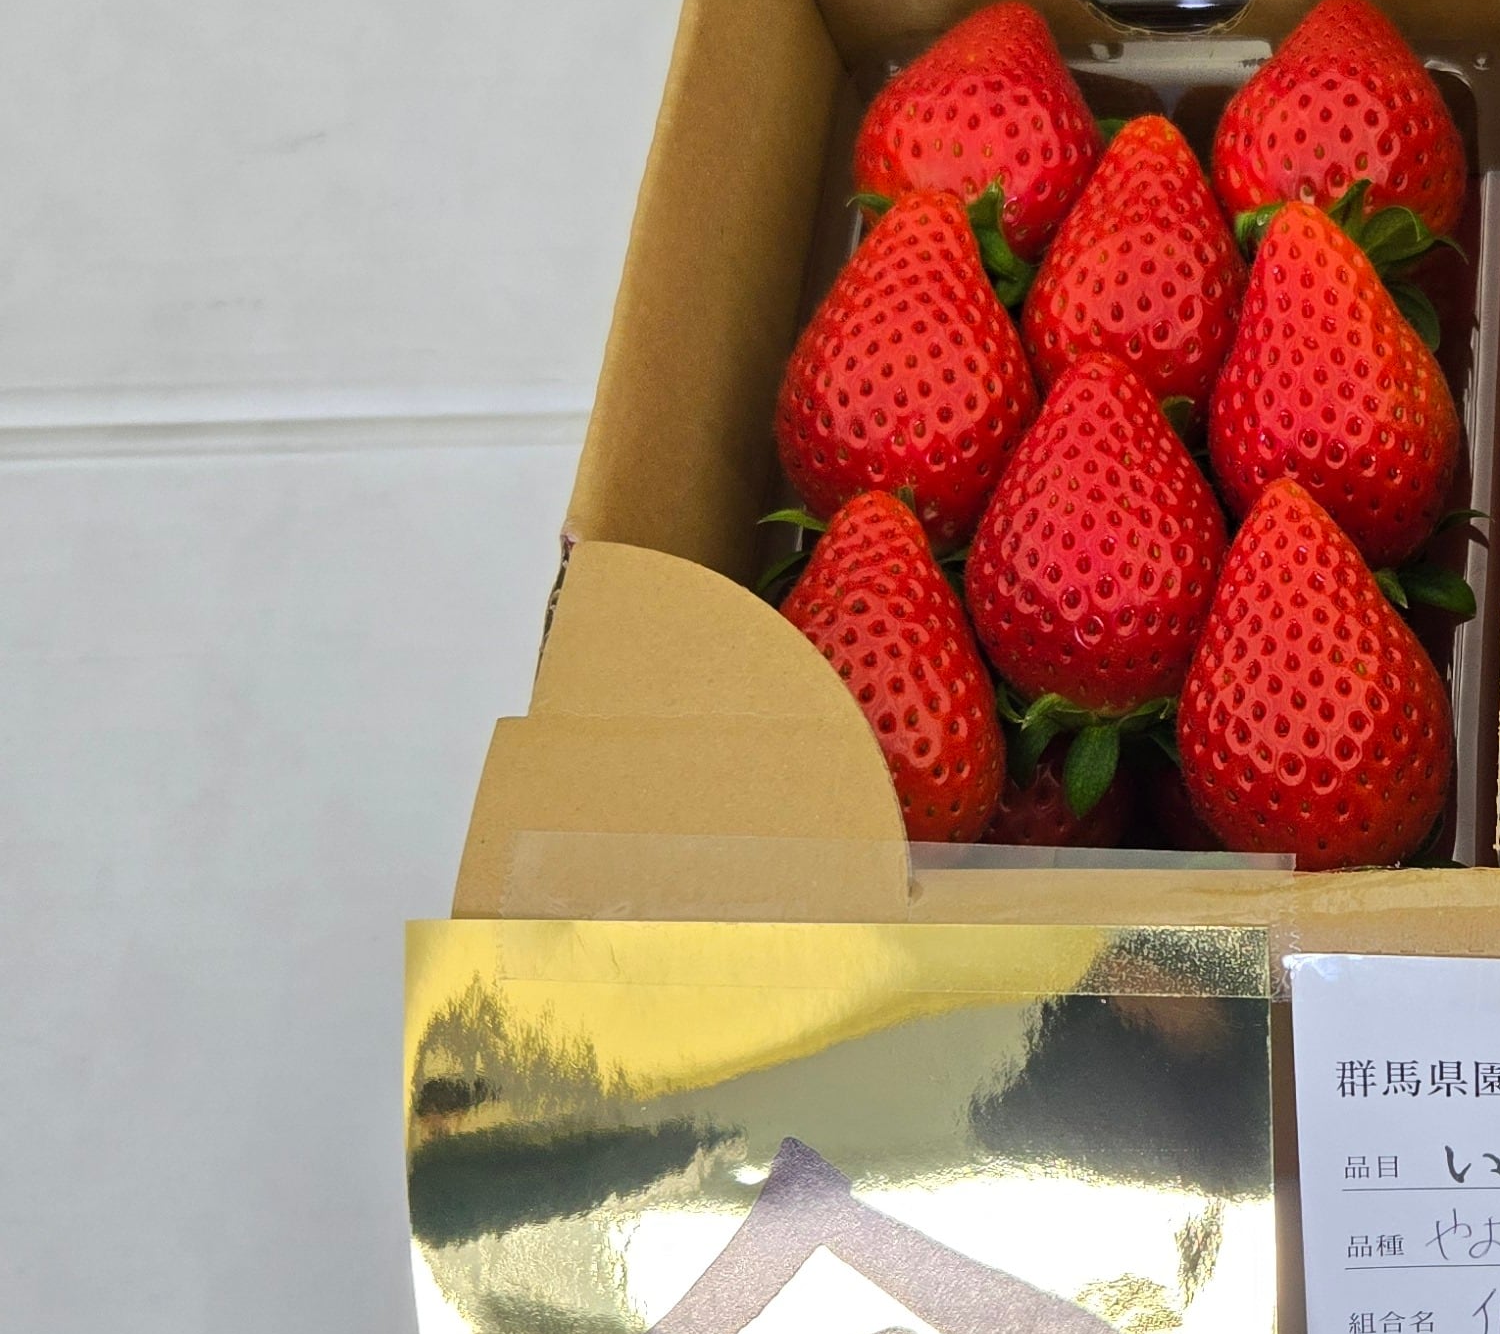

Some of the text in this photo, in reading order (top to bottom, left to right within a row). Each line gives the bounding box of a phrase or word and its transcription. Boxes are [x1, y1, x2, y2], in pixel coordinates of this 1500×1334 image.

[1345, 1156, 1398, 1180] 品目
[1347, 1234, 1404, 1258] 品種
[1348, 1311, 1435, 1334] 組合名
